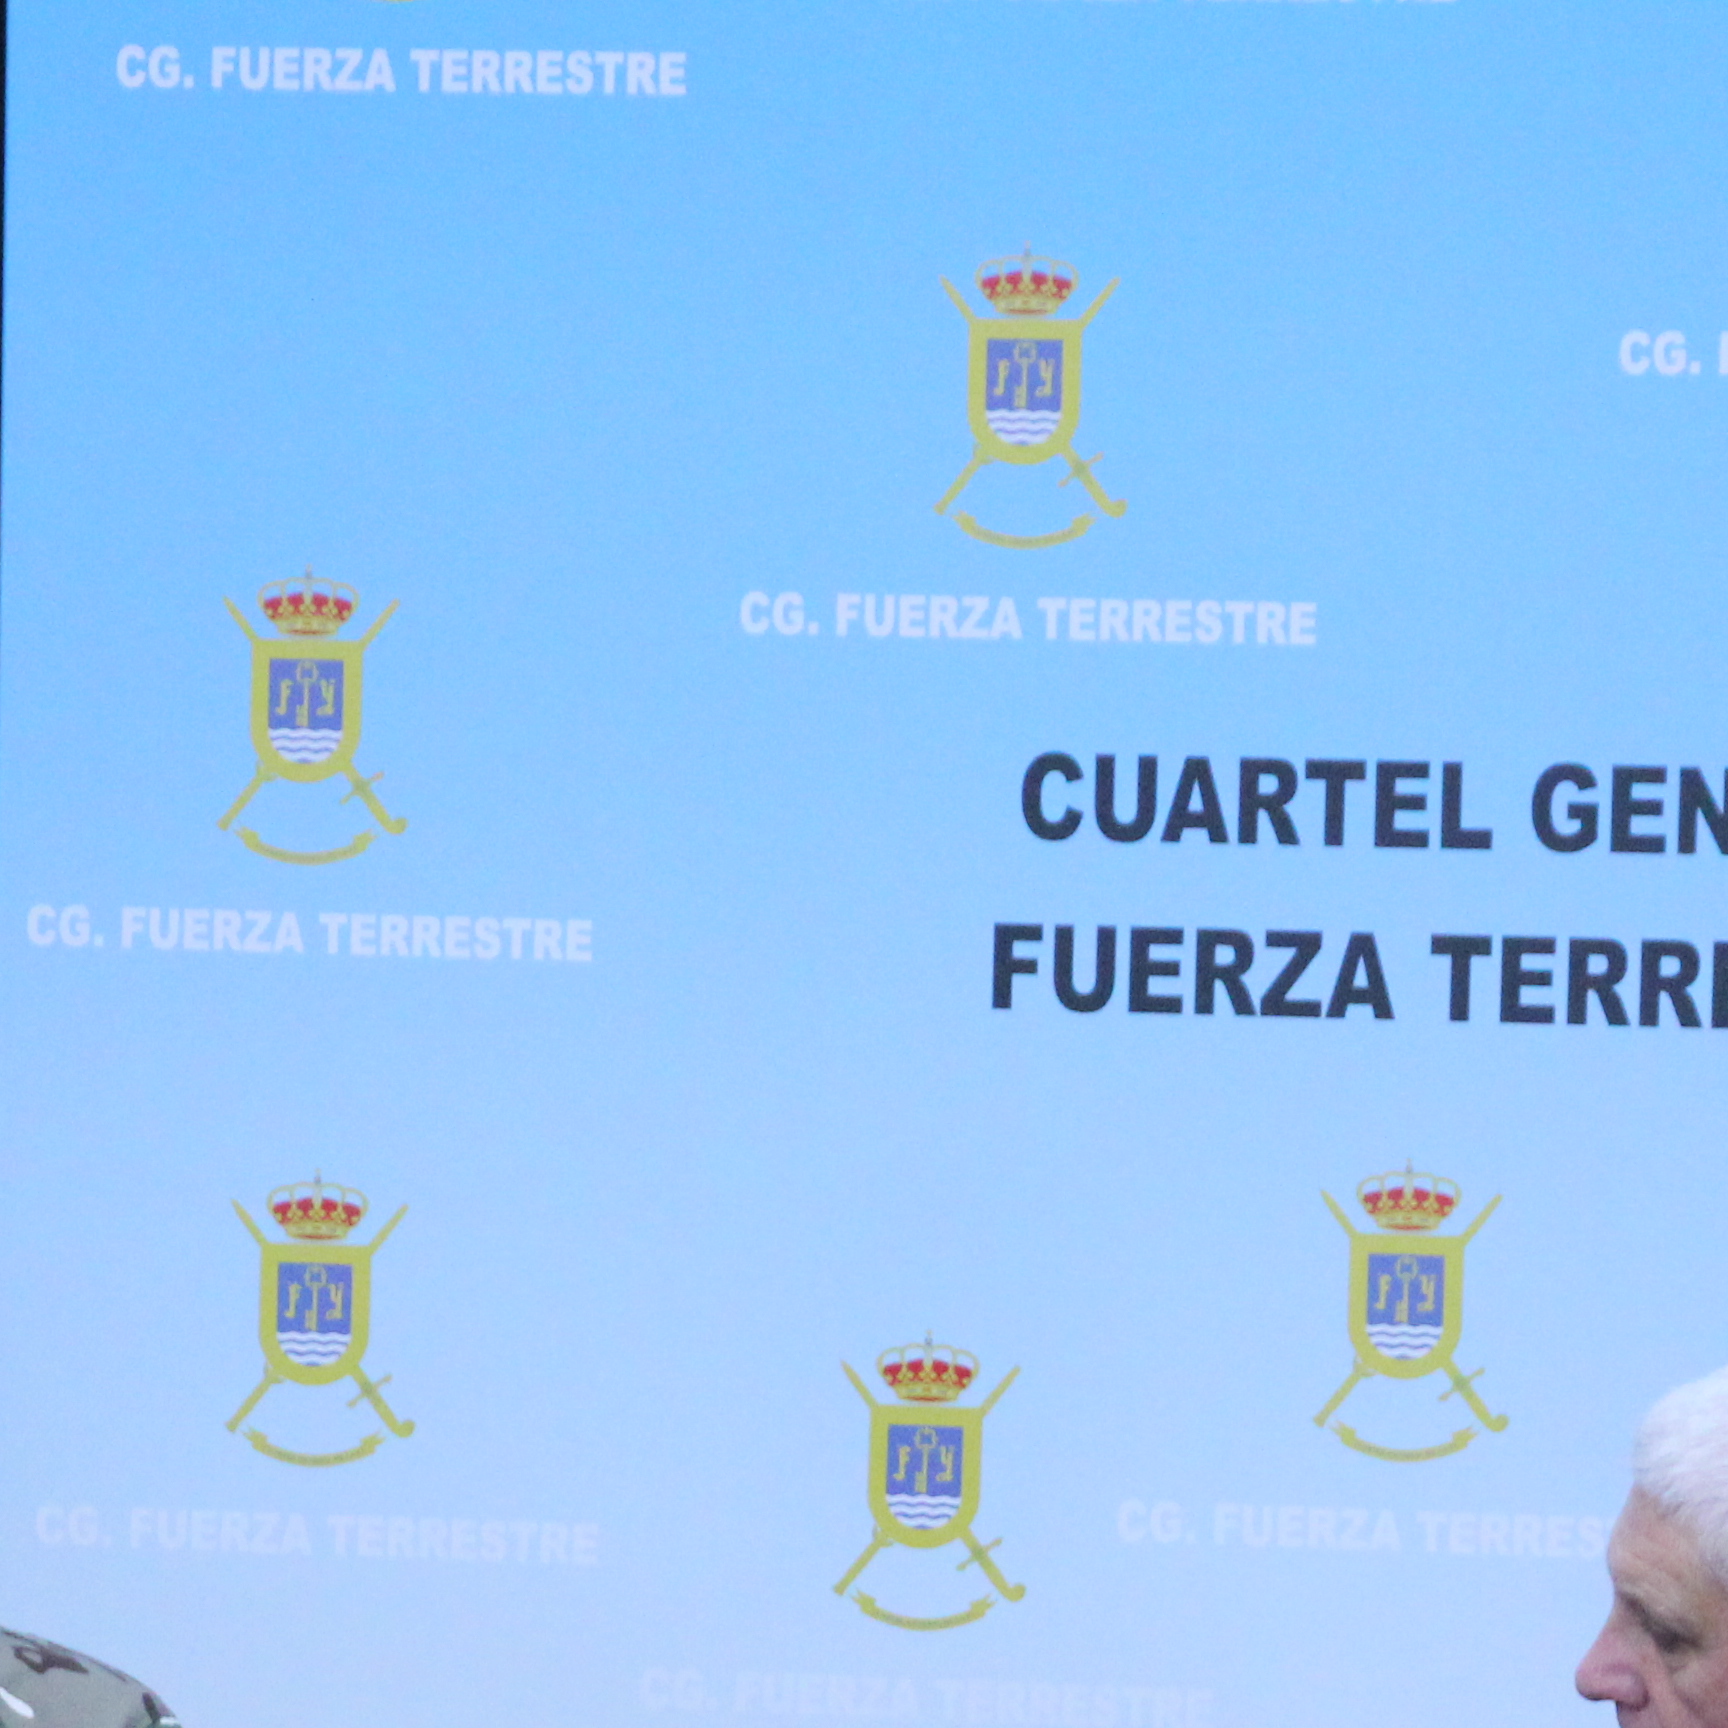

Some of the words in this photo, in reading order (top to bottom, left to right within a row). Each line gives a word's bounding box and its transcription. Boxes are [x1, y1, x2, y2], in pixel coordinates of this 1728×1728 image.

[115, 43, 195, 90] CG.
[210, 45, 396, 93] FUERZA
[409, 48, 687, 97] TERRESTRE
[1618, 329, 1702, 377] CG.
[739, 589, 820, 637] CG.
[835, 592, 1023, 640] FUERZA
[1036, 596, 1317, 646] TERRESTRE
[1021, 752, 1493, 850] CUARTEL
[26, 903, 105, 949] CG.
[120, 906, 305, 954] FUERZA
[318, 912, 593, 963] TERRESTRE
[991, 922, 1396, 1021] FUERZA
[35, 1504, 114, 1549] CG.
[127, 1505, 310, 1555] FUERZA
[326, 1512, 601, 1567] TERRESTRE
[1115, 1498, 1196, 1546] CG.
[1214, 1501, 1401, 1552] FUERZA
[1417, 1510, 1613, 1560] TERRES
